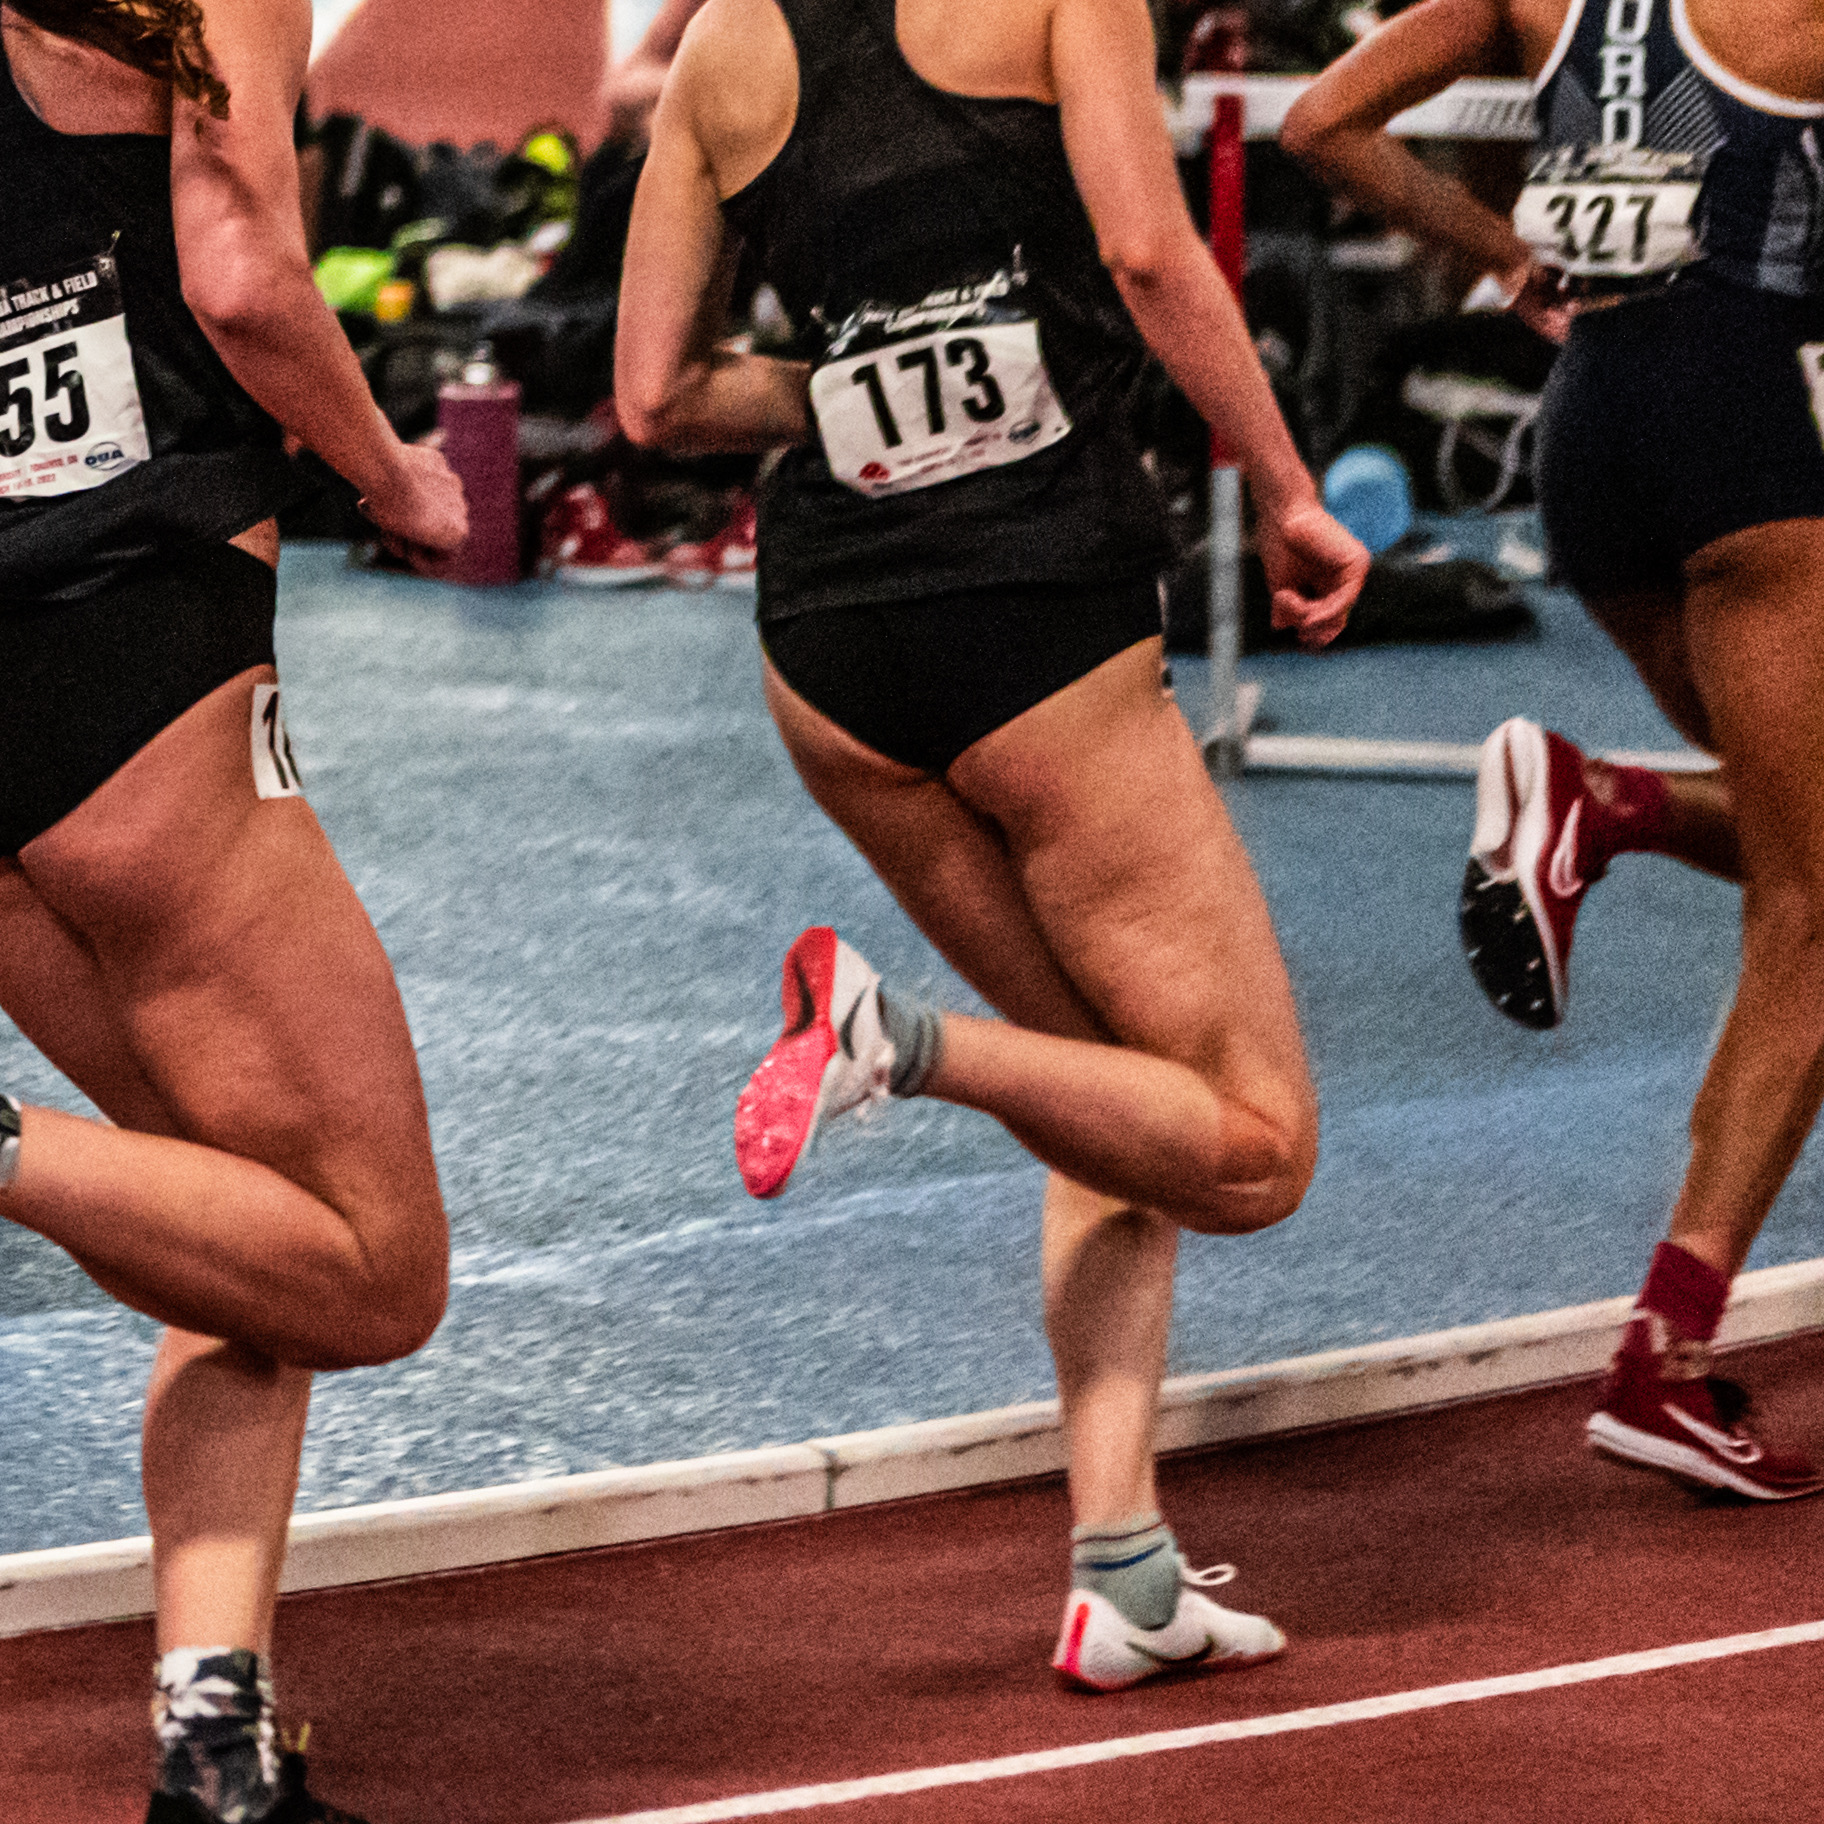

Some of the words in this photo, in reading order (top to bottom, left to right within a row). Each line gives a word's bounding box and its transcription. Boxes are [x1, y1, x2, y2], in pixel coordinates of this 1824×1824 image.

[1544, 192, 1658, 264] 327
[11, 286, 51, 312] TRACK
[51, 282, 63, 300] &
[63, 271, 99, 297] FIELD
[851, 337, 1006, 449] 173
